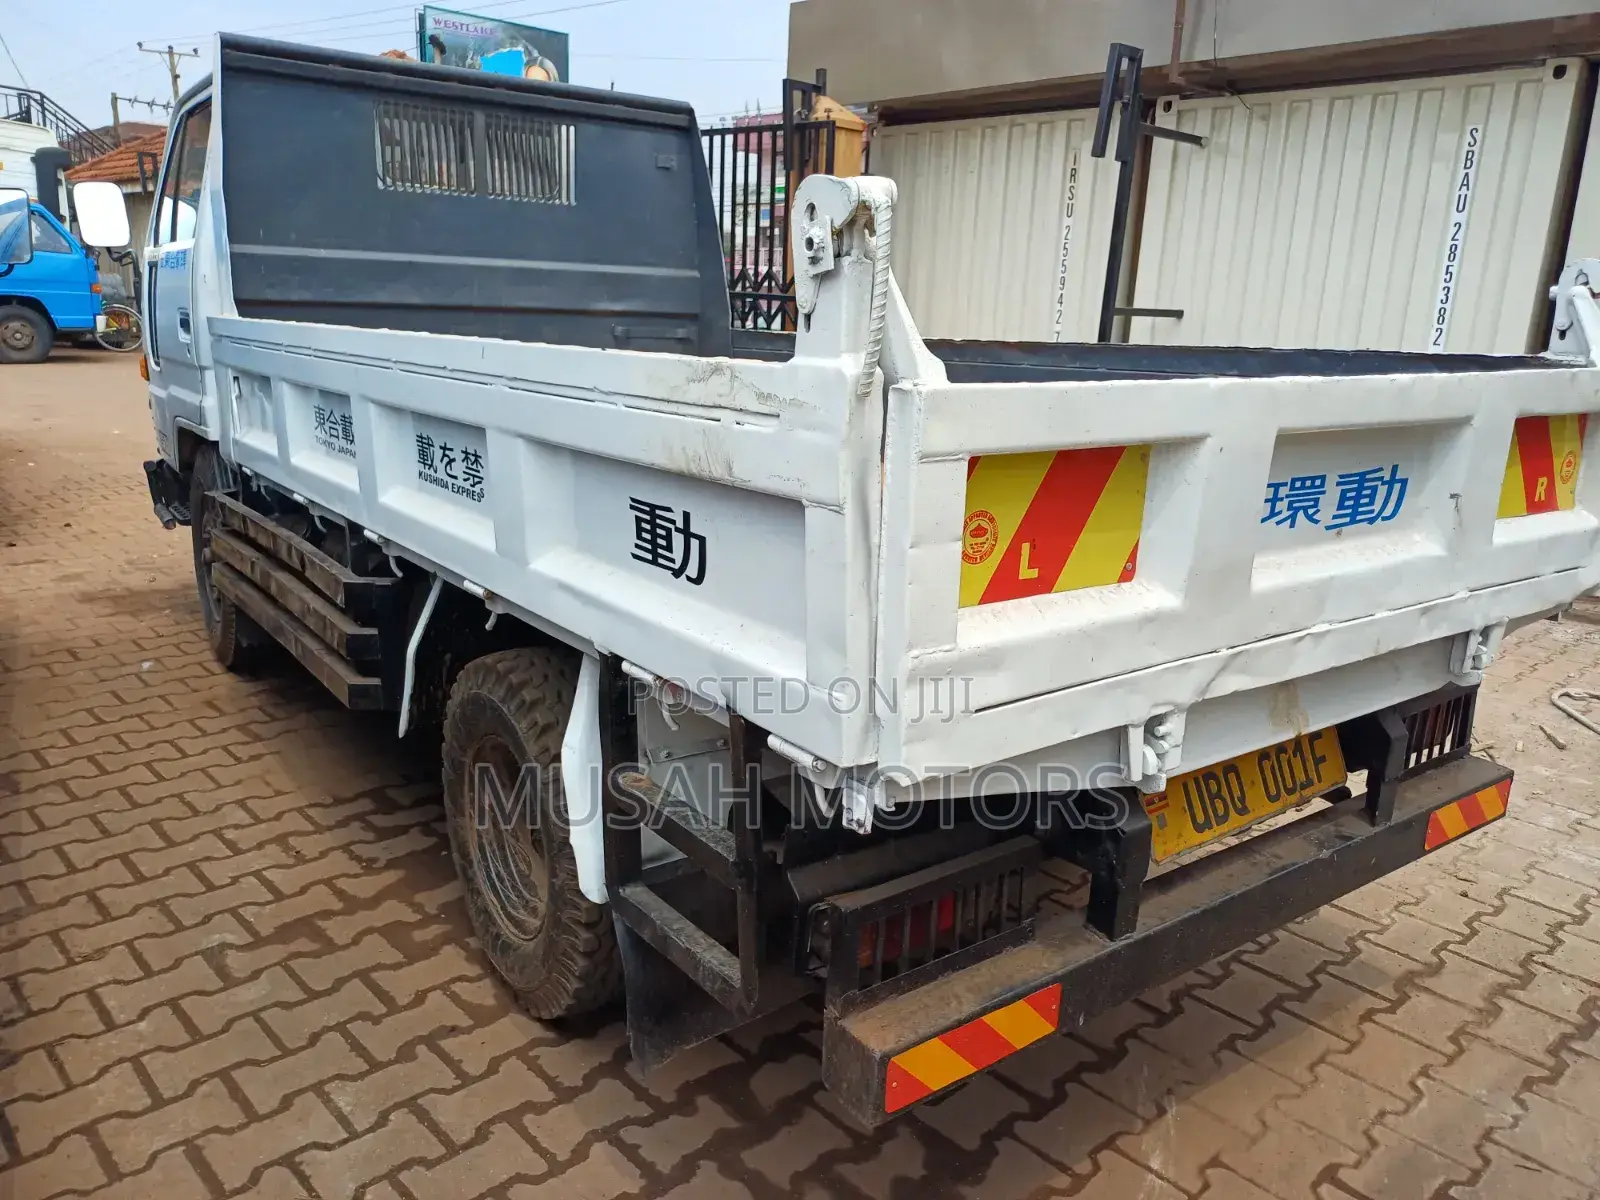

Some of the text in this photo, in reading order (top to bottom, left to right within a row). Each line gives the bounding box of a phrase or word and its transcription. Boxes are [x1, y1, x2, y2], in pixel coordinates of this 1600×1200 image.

[432, 17, 498, 36] WESTLAKE
[1066, 153, 1077, 218] IRSU
[1433, 127, 1478, 346] SBAU 285382
[1055, 225, 1071, 325] 255942
[314, 435, 336, 451] TOKYO
[418, 469, 450, 491] KUSHIDA
[1260, 463, 1409, 531] 環動
[1534, 476, 1548, 502] R
[628, 496, 707, 586] 動
[1019, 542, 1039, 580] L
[1182, 732, 1328, 834] UBQ 001F
